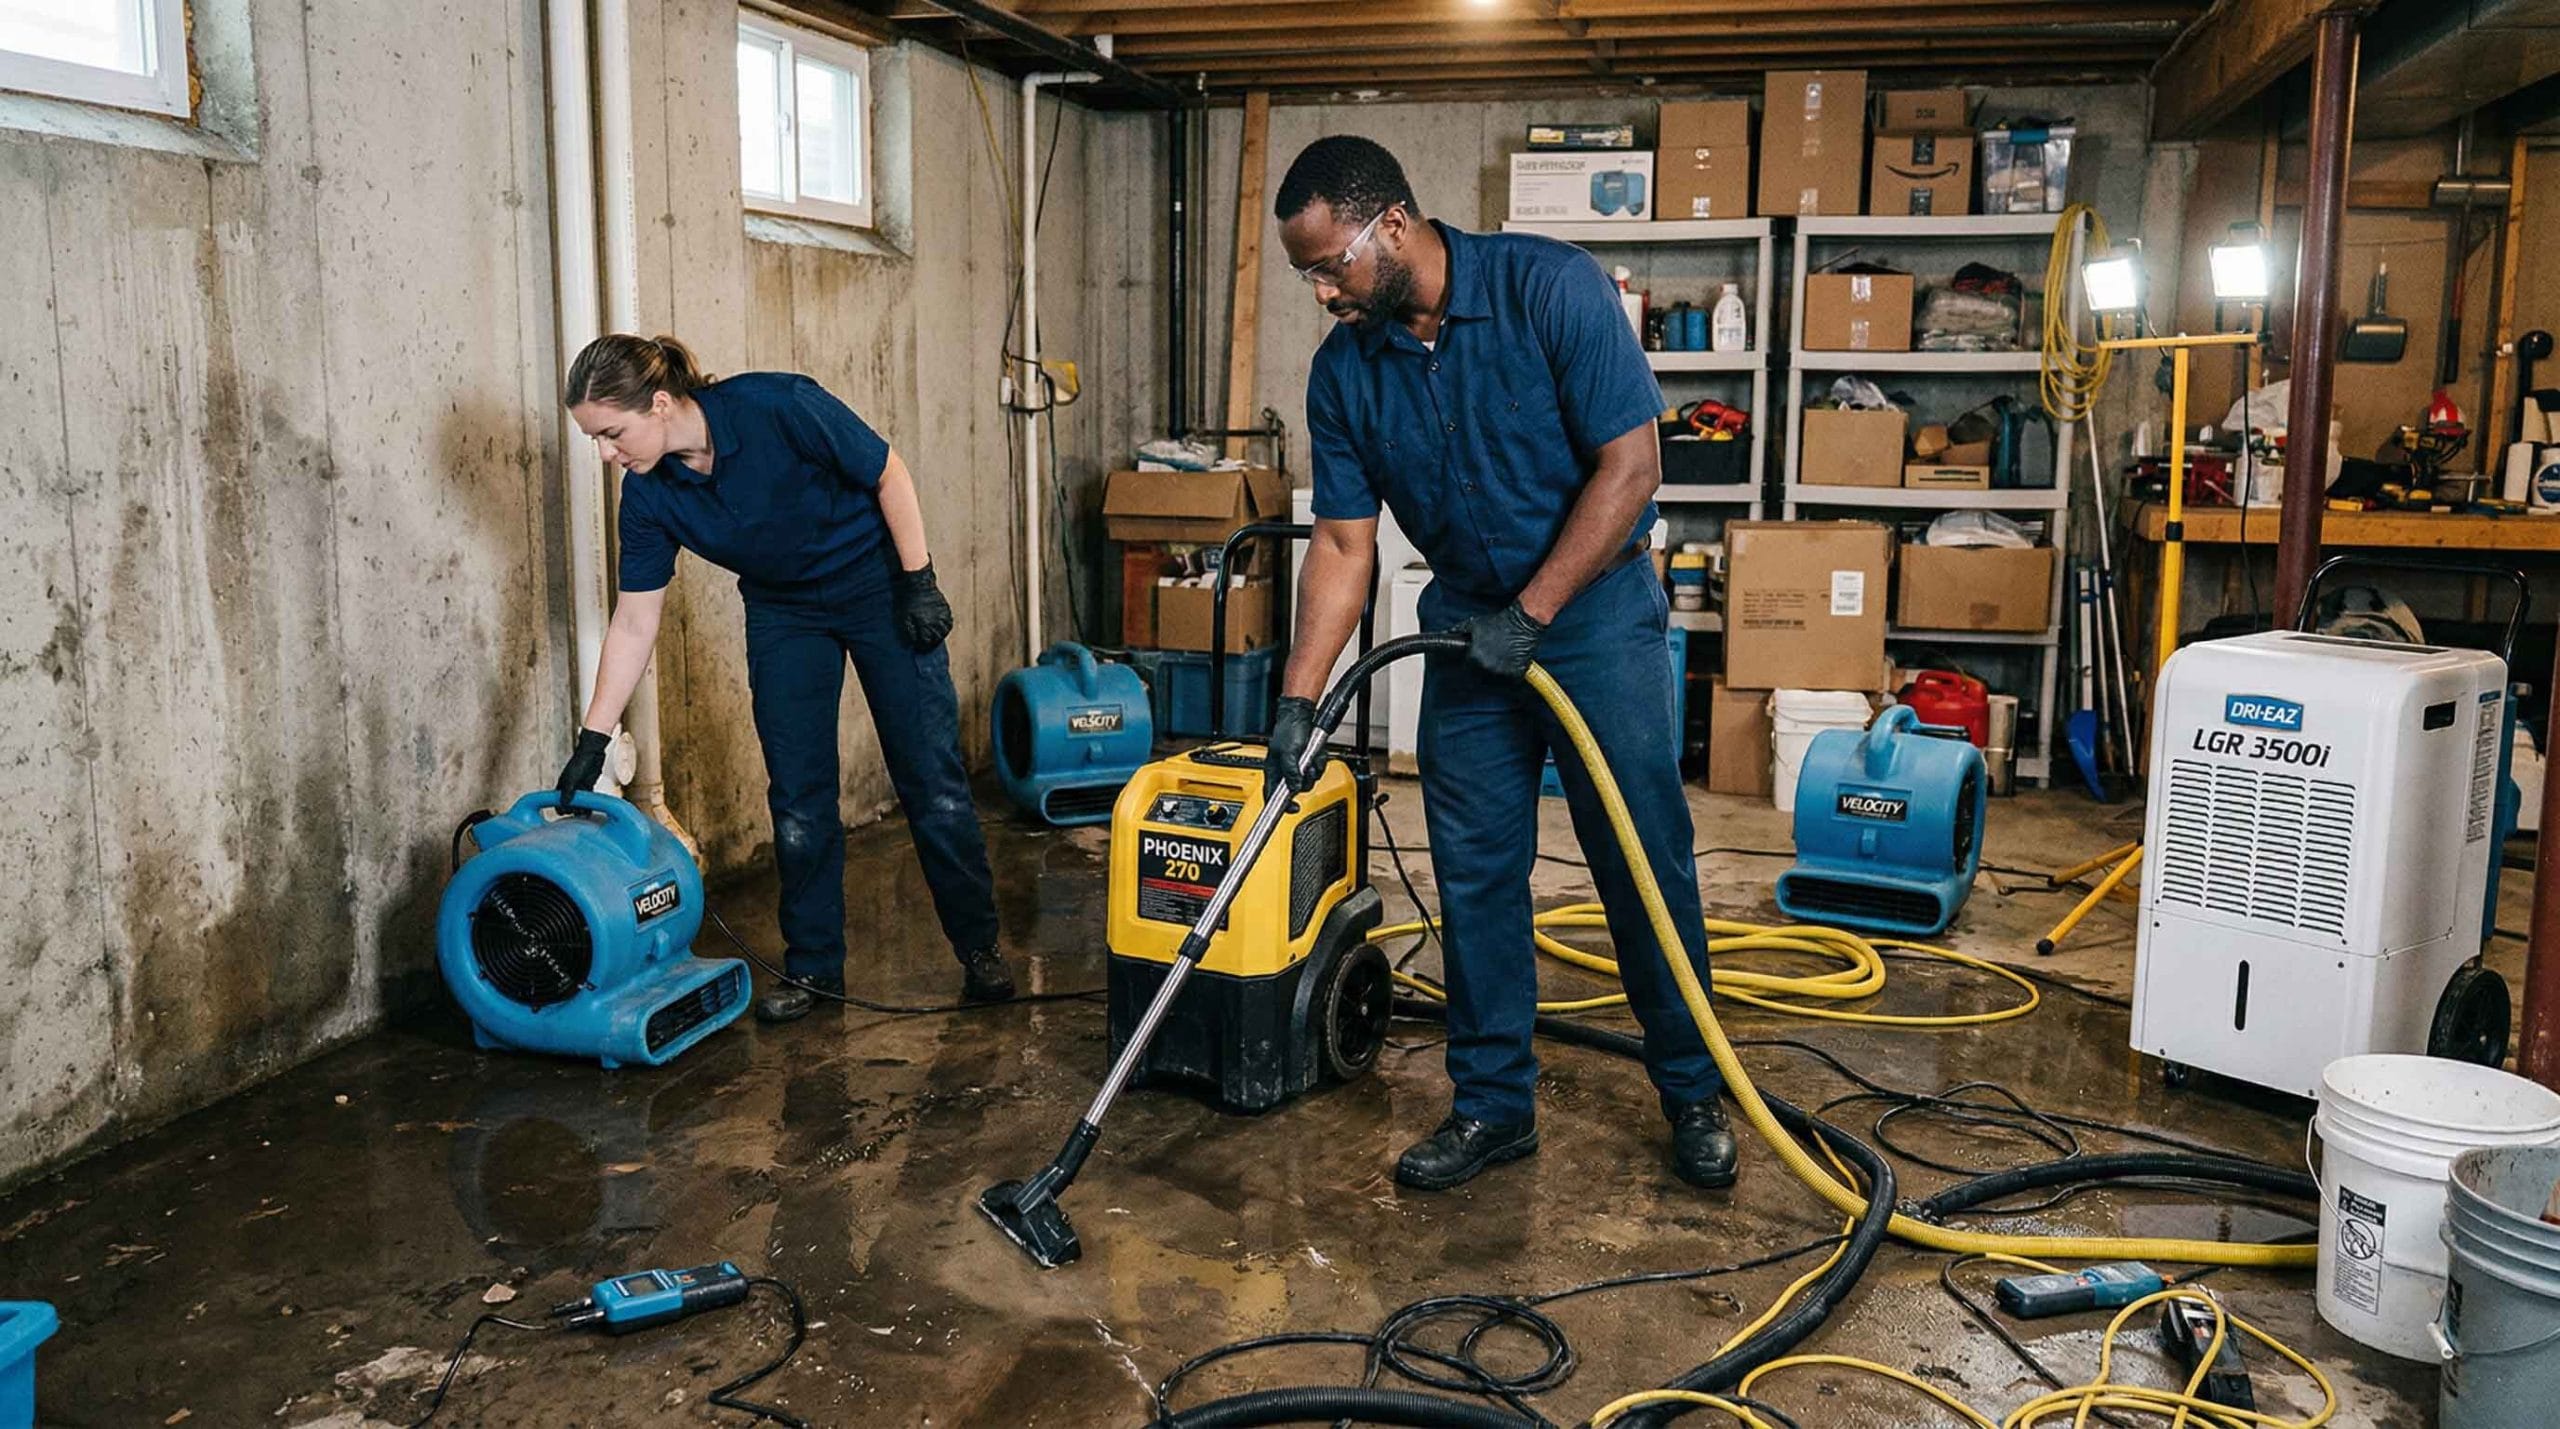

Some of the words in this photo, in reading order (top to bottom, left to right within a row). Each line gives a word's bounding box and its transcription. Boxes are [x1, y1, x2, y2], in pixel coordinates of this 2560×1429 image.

[2193, 728, 2245, 756] LGR
[2249, 736, 2332, 767] 3500i
[1842, 796, 1904, 814] VELOCITY
[1144, 837, 1223, 866] PHOENIX
[1165, 859, 1200, 881] 270
